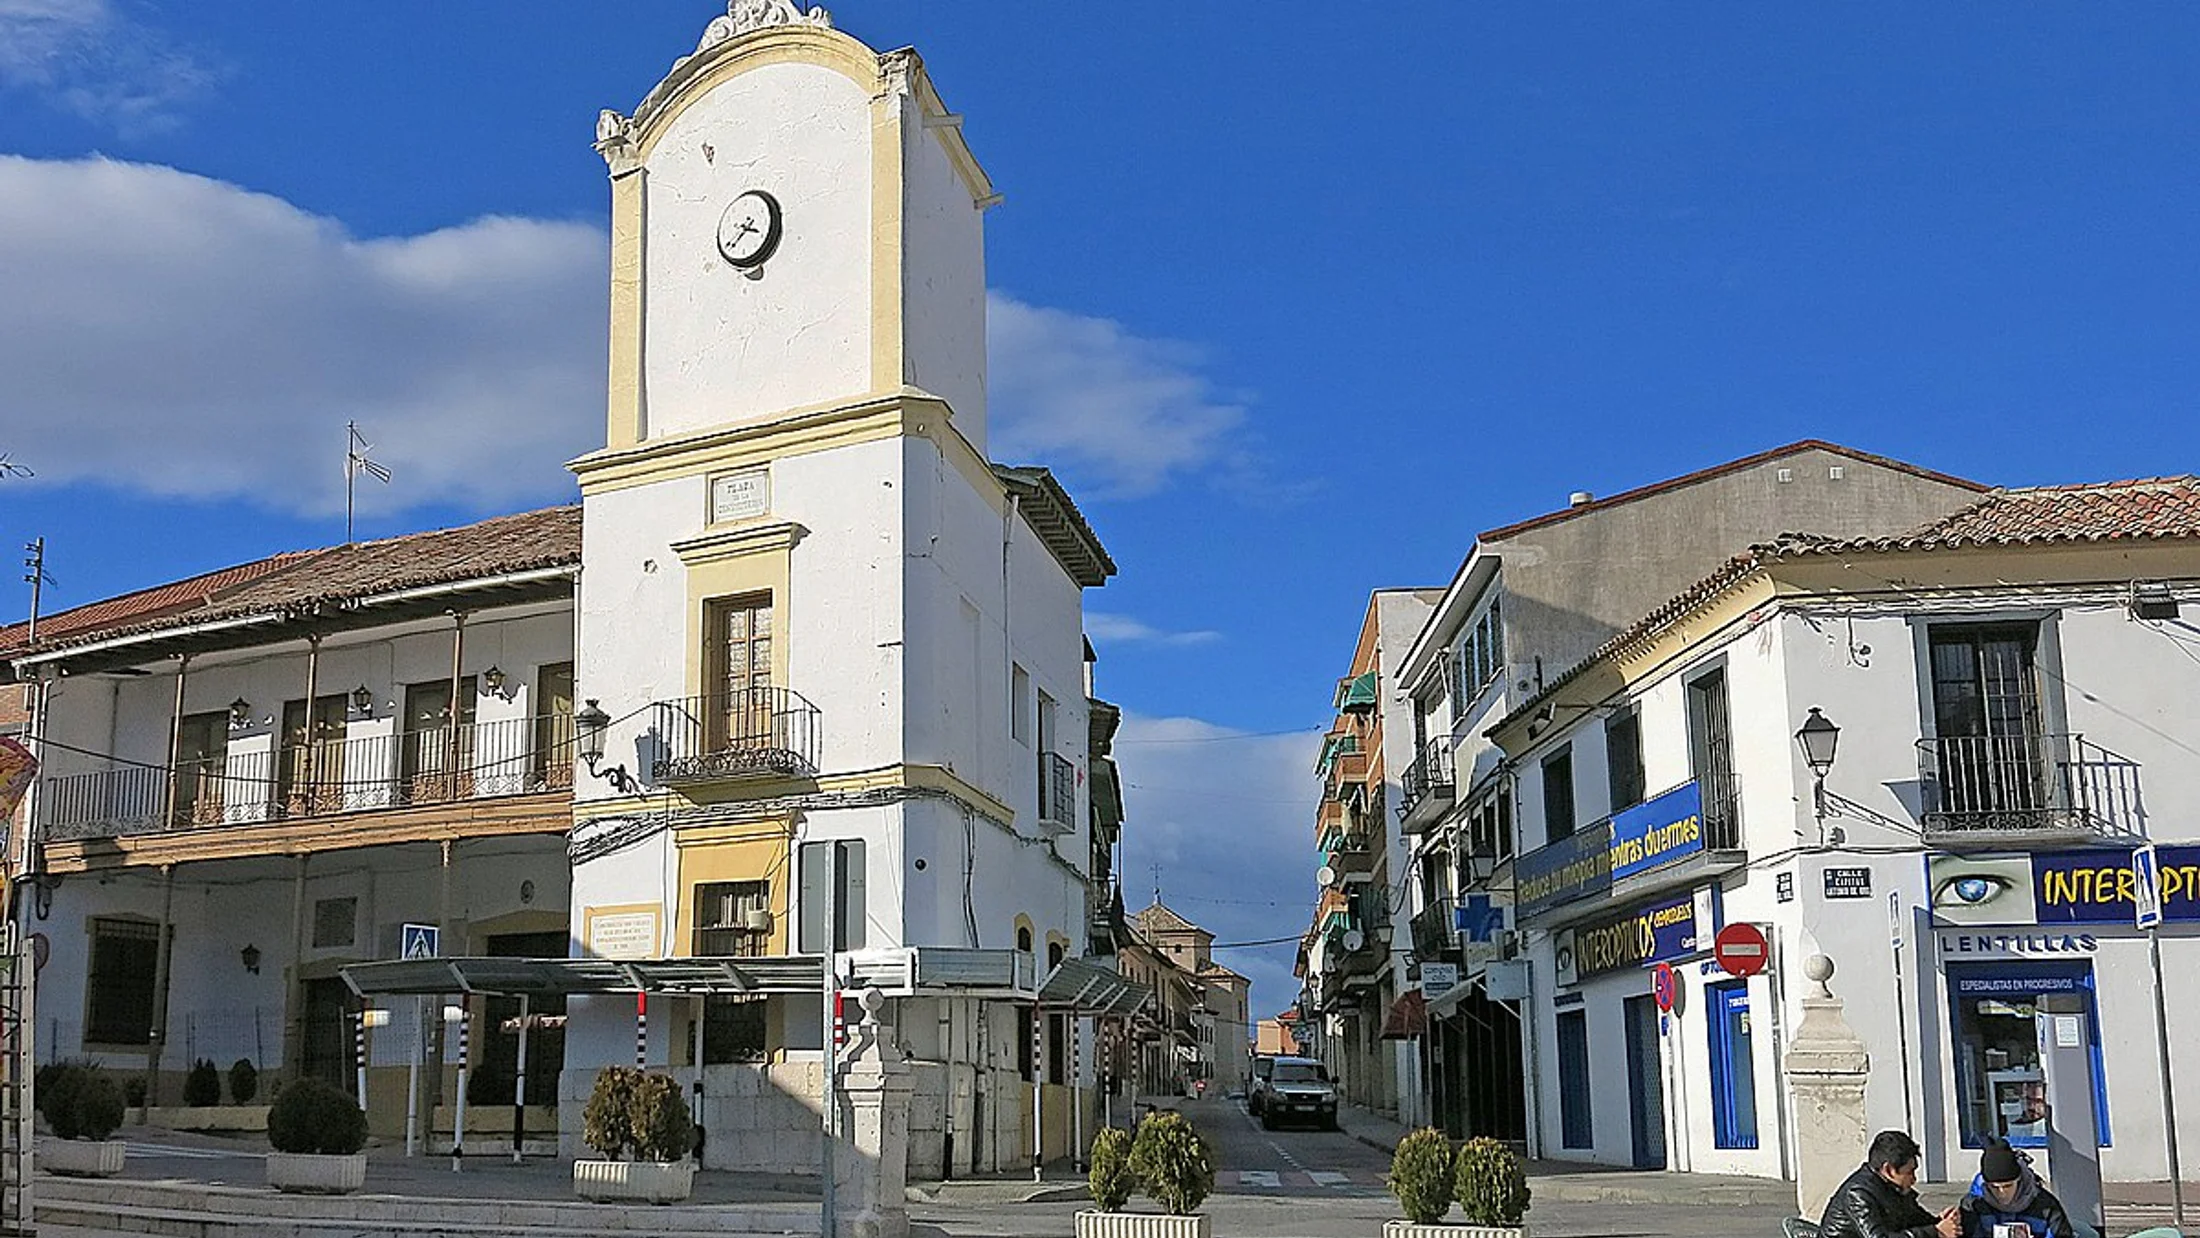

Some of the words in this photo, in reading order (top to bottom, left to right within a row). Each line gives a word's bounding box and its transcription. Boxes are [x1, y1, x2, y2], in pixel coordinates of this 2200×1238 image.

[1644, 815, 1700, 857] duermes
[2043, 866, 2200, 906] INTERPT
[1578, 911, 1656, 975] INTEROPTICOS
[1942, 933, 2099, 952] LENTILLAS
[1960, 979, 2013, 991] ESPECIALISTAS
[2013, 979, 2023, 990] EN
[2024, 978, 2073, 990] PROGRESIVOS
